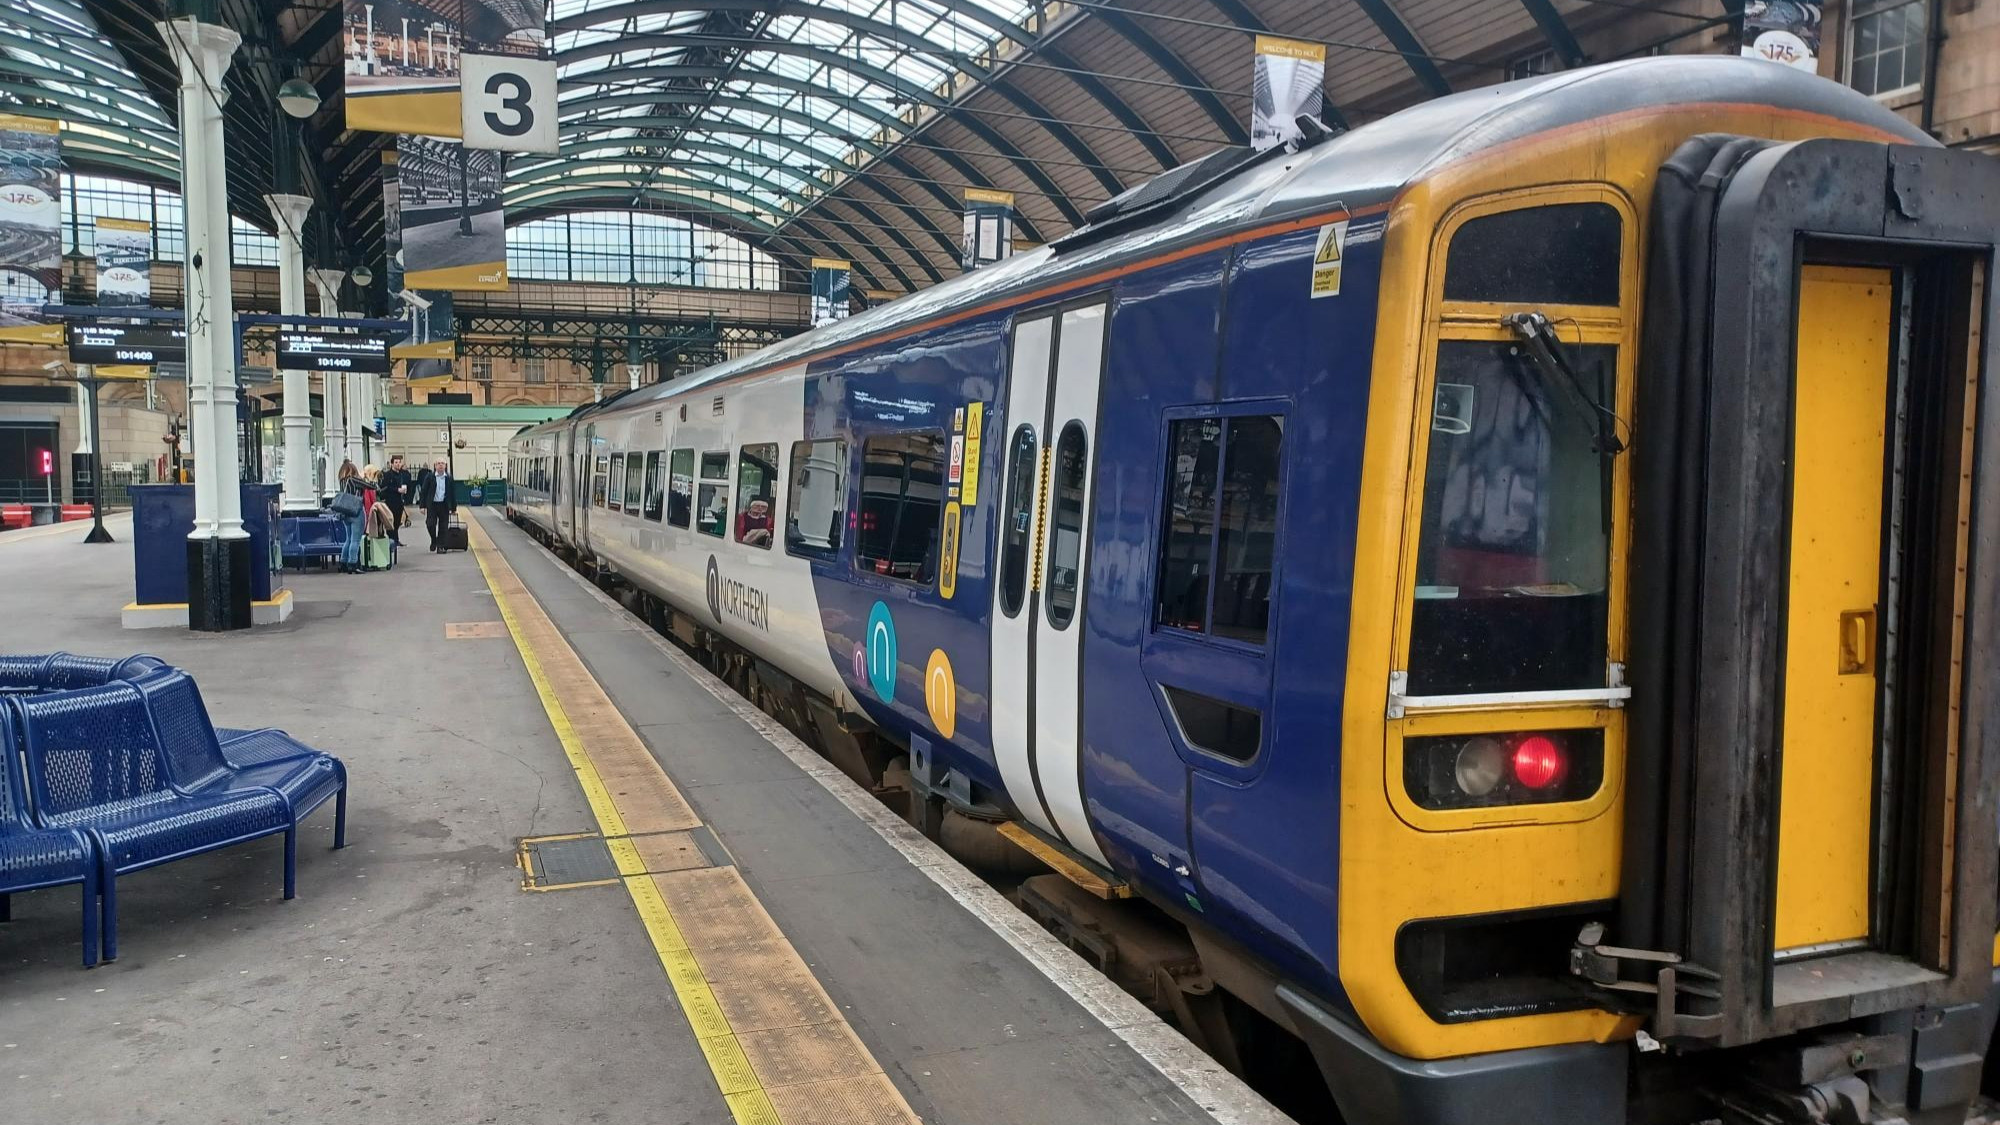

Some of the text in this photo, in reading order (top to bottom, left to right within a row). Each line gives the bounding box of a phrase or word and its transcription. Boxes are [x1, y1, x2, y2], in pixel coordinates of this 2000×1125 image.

[1769, 44, 1793, 60] 175
[483, 72, 535, 136] 3
[10, 193, 35, 203] 175
[1315, 270, 1335, 279] Danger
[720, 575, 769, 632] NORTHERN
